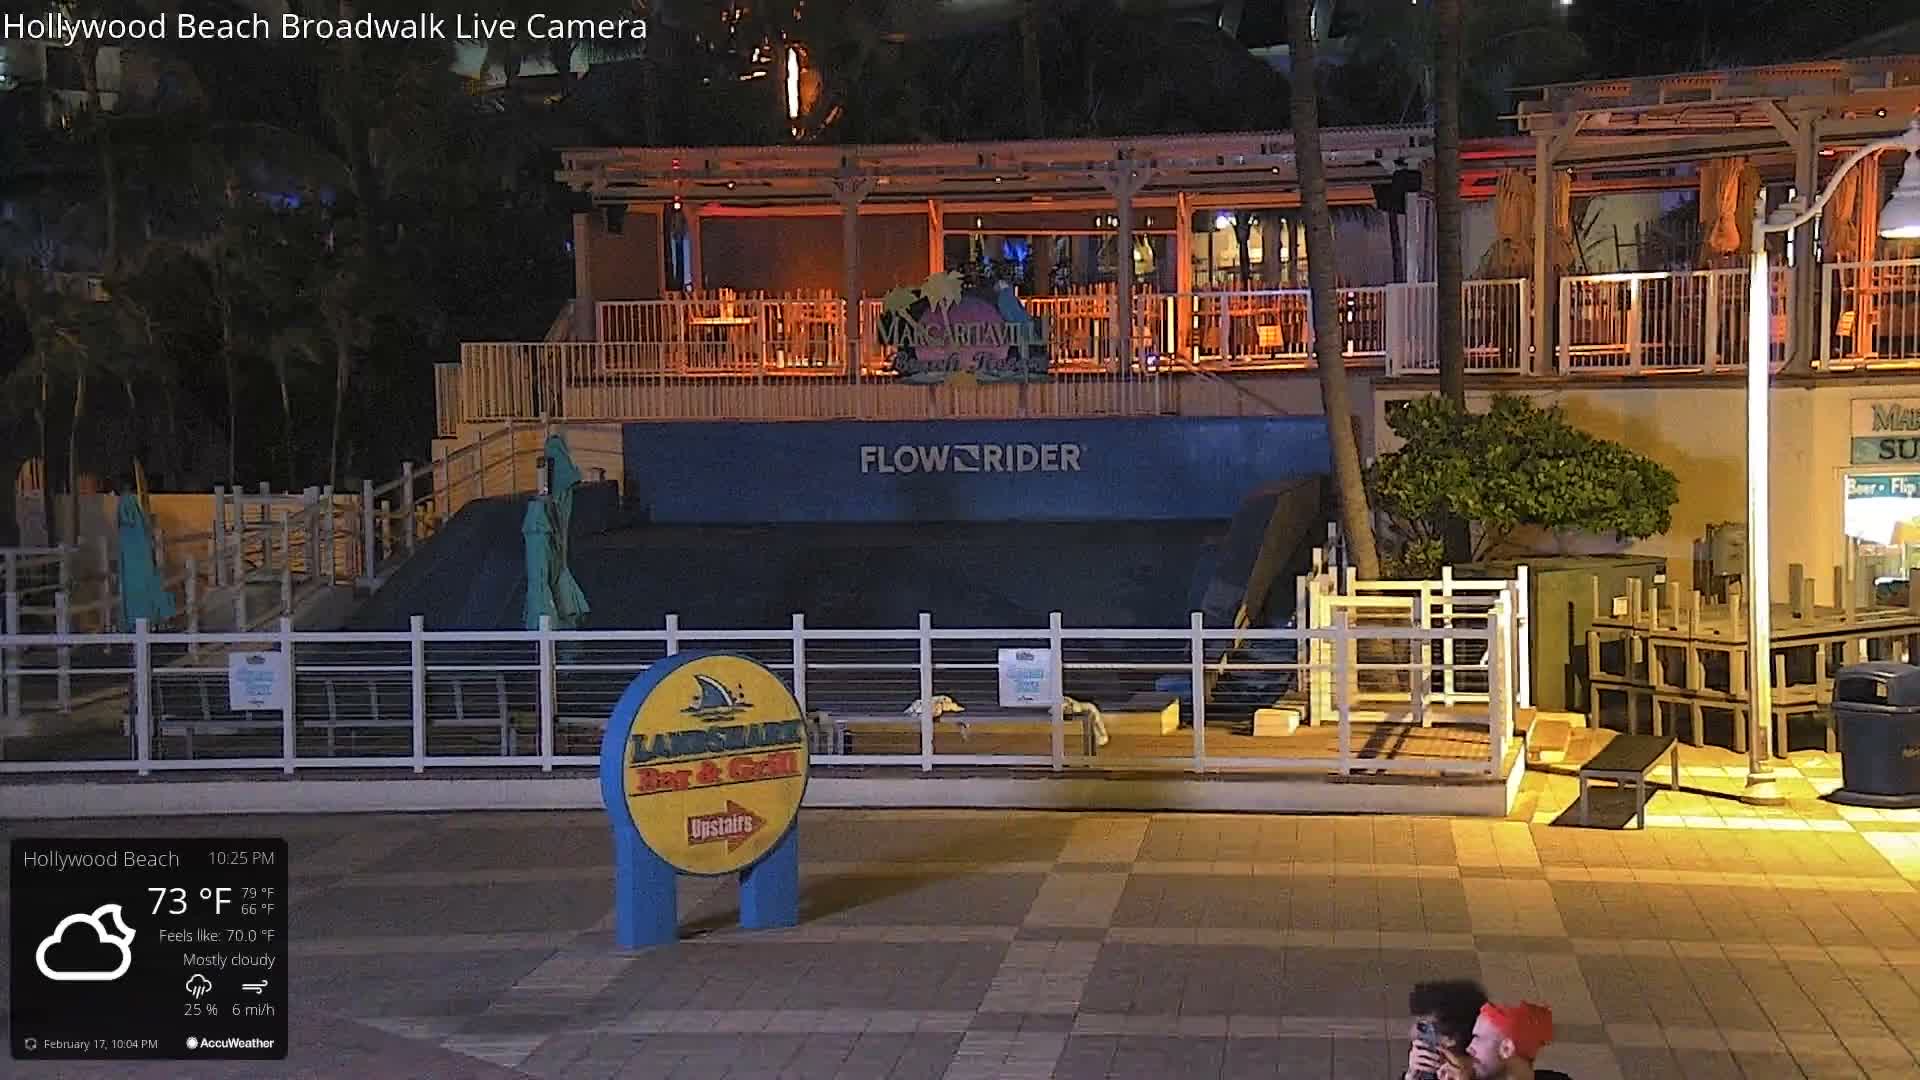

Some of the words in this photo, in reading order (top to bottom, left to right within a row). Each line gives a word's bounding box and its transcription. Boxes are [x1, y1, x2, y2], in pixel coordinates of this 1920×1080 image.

[860, 446, 951, 473] FLOW
[983, 444, 1082, 472] RIDER
[637, 767, 693, 792] Bar
[696, 760, 722, 784] &
[728, 751, 798, 779] Grill
[690, 815, 753, 839] Upstairs
